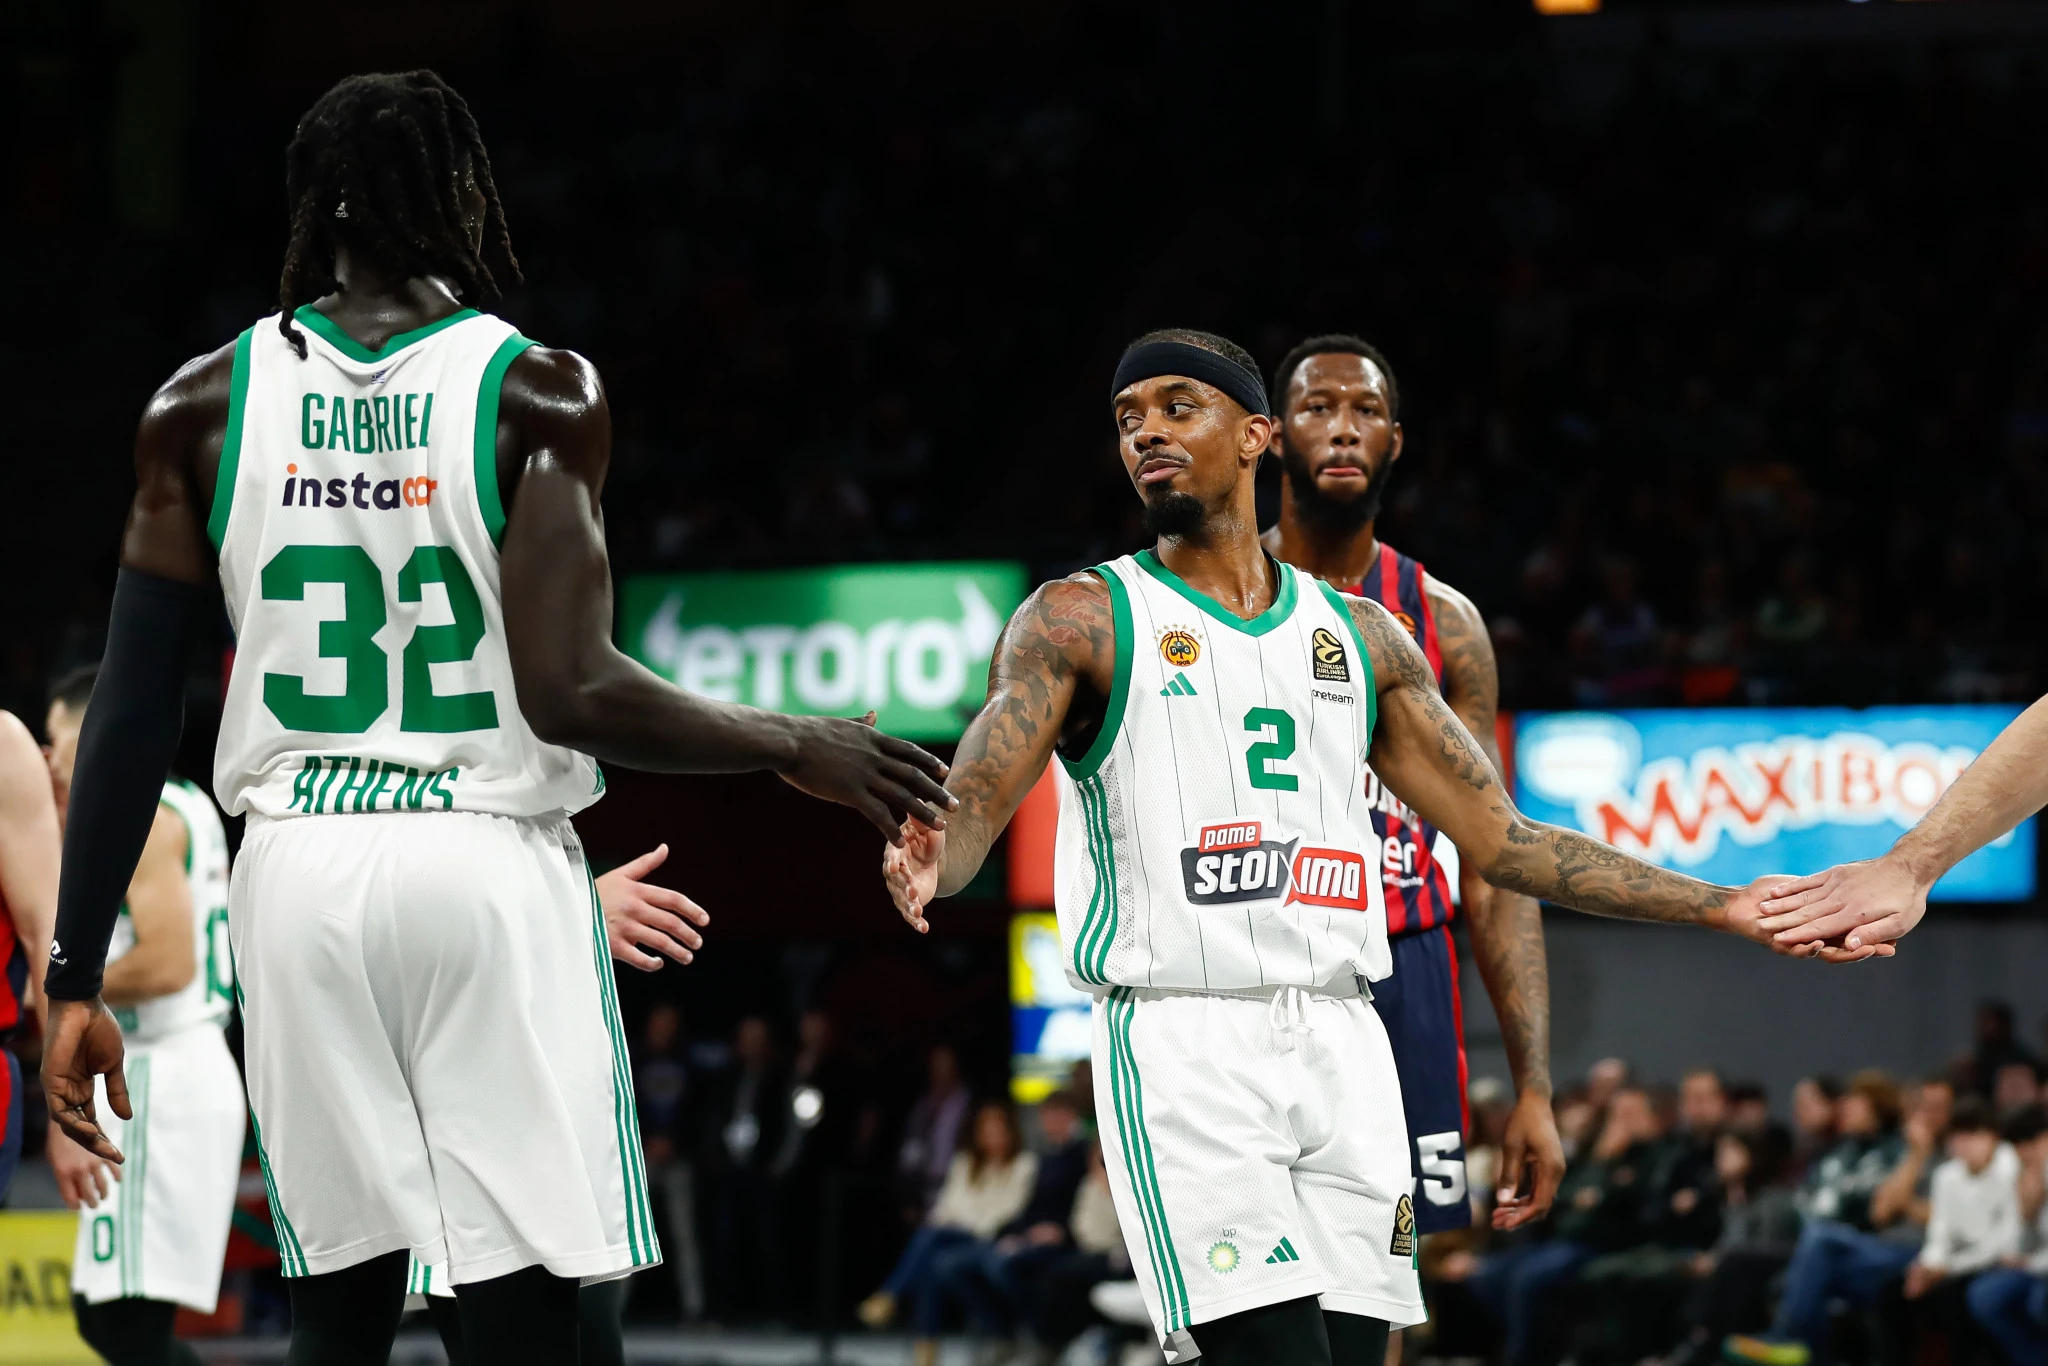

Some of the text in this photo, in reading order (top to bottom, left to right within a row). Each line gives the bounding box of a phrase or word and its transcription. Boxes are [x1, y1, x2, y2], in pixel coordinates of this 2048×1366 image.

[302, 393, 433, 454] GABRIEL
[262, 545, 500, 733] 32
[1316, 661, 1345, 670] TURKISH
[1316, 667, 1346, 675] AIRLINES
[1243, 706, 1299, 792] 2
[286, 755, 460, 814] ATHENS
[1597, 739, 1966, 848] MAXIBO
[1204, 825, 1257, 850] pame
[1412, 1130, 1466, 1206] 5
[1221, 1227, 1237, 1239] bp
